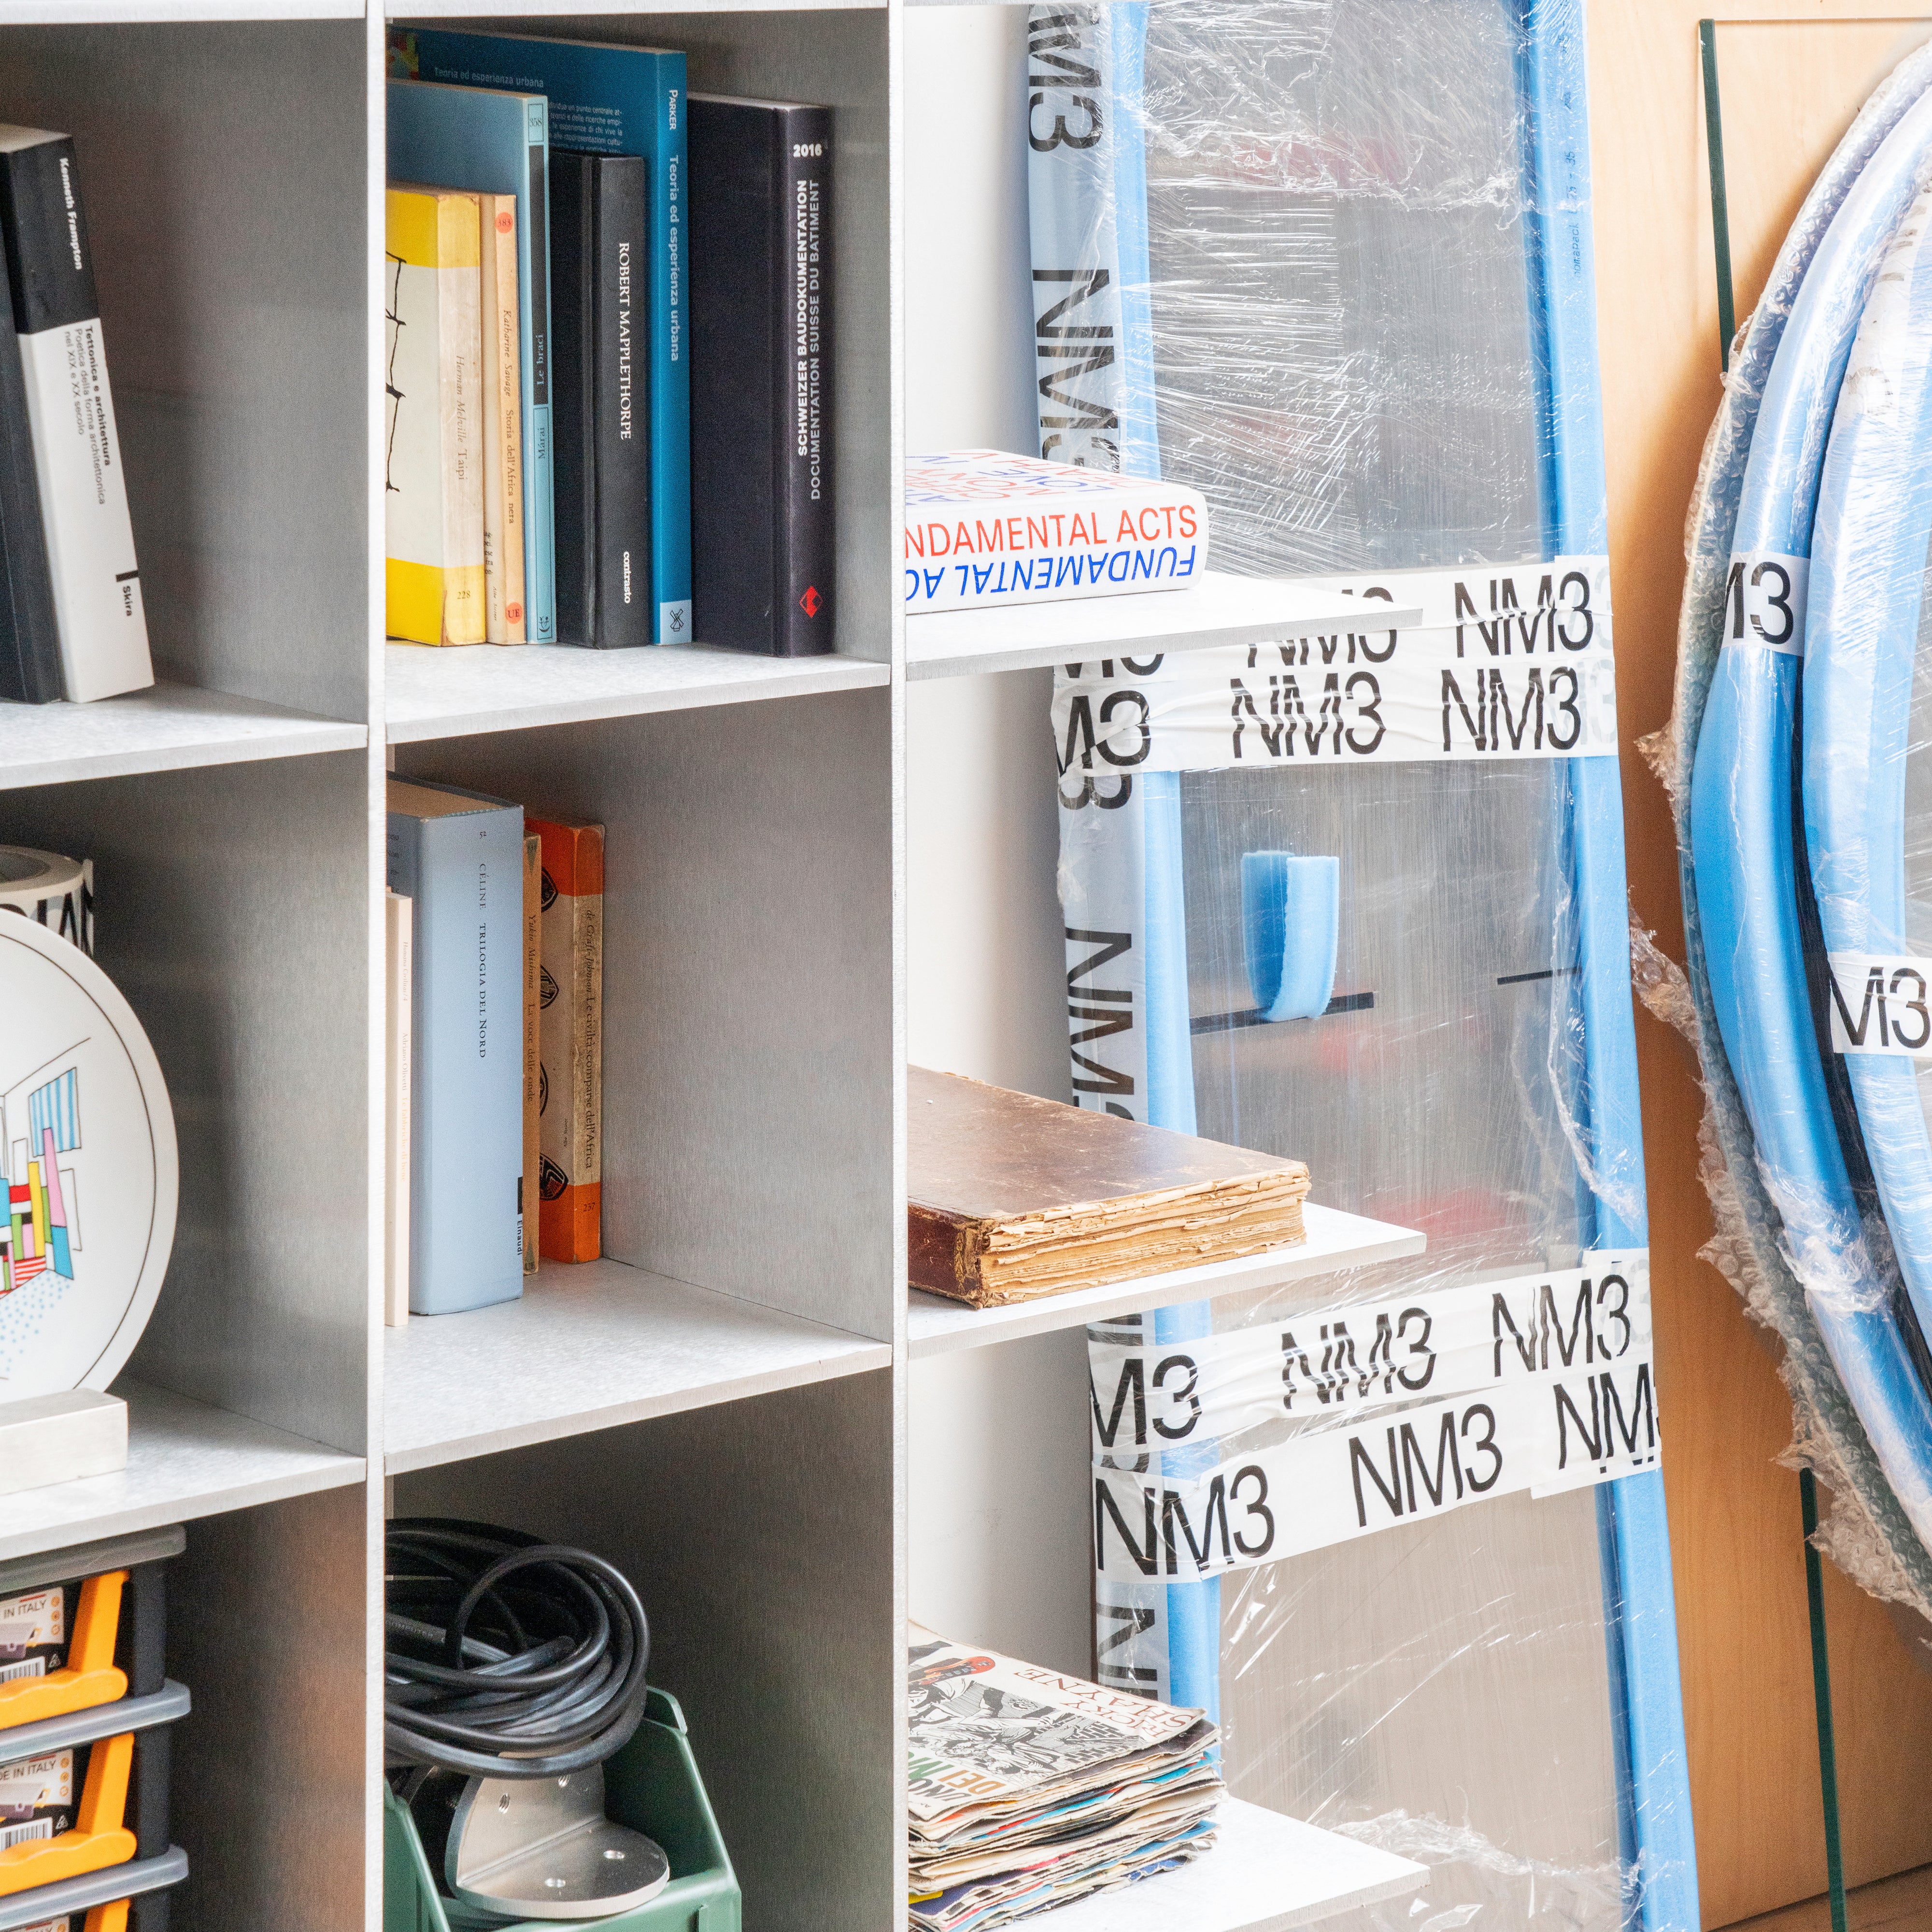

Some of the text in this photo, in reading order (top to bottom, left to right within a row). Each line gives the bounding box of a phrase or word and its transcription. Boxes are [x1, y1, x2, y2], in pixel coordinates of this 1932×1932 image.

[435, 68, 544, 88] Teoria ed esperienza urbana
[529, 117, 542, 127] 358
[668, 90, 678, 130] PARKER
[793, 143, 822, 158] 2016
[59, 157, 84, 270] Kenneth Frampton
[497, 218, 511, 227] 383
[668, 156, 679, 361] Teoria ed esperienza urbana
[1569, 223, 1581, 278] nomapack
[503, 310, 512, 357] Katharine
[797, 180, 808, 456] SCHWEIZER BAUDOKUMENTATION
[619, 242, 632, 440] ROBERT MAPPLETHORPE
[809, 180, 820, 500] DOCUMENTATION SUISSE DU BATIMENT
[68, 350, 77, 370] XIX
[536, 334, 544, 385] Le braci
[72, 382, 81, 398] XX
[85, 326, 99, 382] Tettonica
[95, 396, 111, 466] architettura
[504, 364, 512, 397] Savage
[75, 328, 105, 505] Poetica della forma architettonica
[75, 400, 85, 435] secolo
[455, 355, 468, 481] Herman Melville Taipi
[506, 410, 514, 439] Storia
[537, 427, 545, 459] Márai
[506, 445, 515, 497] dell'Africa
[978, 469, 1116, 492] LOVE
[992, 459, 1165, 488] DEATH
[1116, 505, 1197, 543] ACTS
[955, 545, 1196, 597] FUNDAMENTAL
[121, 585, 133, 617] Skira
[457, 590, 471, 600] 228
[508, 609, 520, 619] UE
[1454, 571, 1594, 658] NM3
[1230, 670, 1388, 759] NM3
[1442, 666, 1582, 753] NM3
[480, 831, 487, 839] 52
[479, 863, 489, 910] CÉLINE
[528, 914, 537, 942] Yukio
[528, 947, 537, 989] Mishima
[527, 1004, 536, 1016] La
[1065, 927, 1135, 1122] NM
[583, 910, 596, 1169] de Graft-Johnson Le civiltà scomparse dell'Africa
[527, 1049, 536, 1072] delle
[401, 1097, 408, 1107] Le
[527, 1077, 536, 1102] onde
[401, 1151, 408, 1163] di
[583, 1202, 596, 1212] 237
[1281, 1307, 1438, 1409] NM3
[1492, 1274, 1632, 1377] NM3
[1095, 1363, 1661, 1577] NM3 NM3 NM
[3, 1598, 47, 1619] IN ITALY
[1013, 1668, 1198, 1728] SHAYNE
[1060, 1700, 1172, 1738] RICKY
[13, 1767, 24, 1778] IN
[27, 1760, 56, 1775] ITALY
[937, 1769, 1008, 1795] DEI
